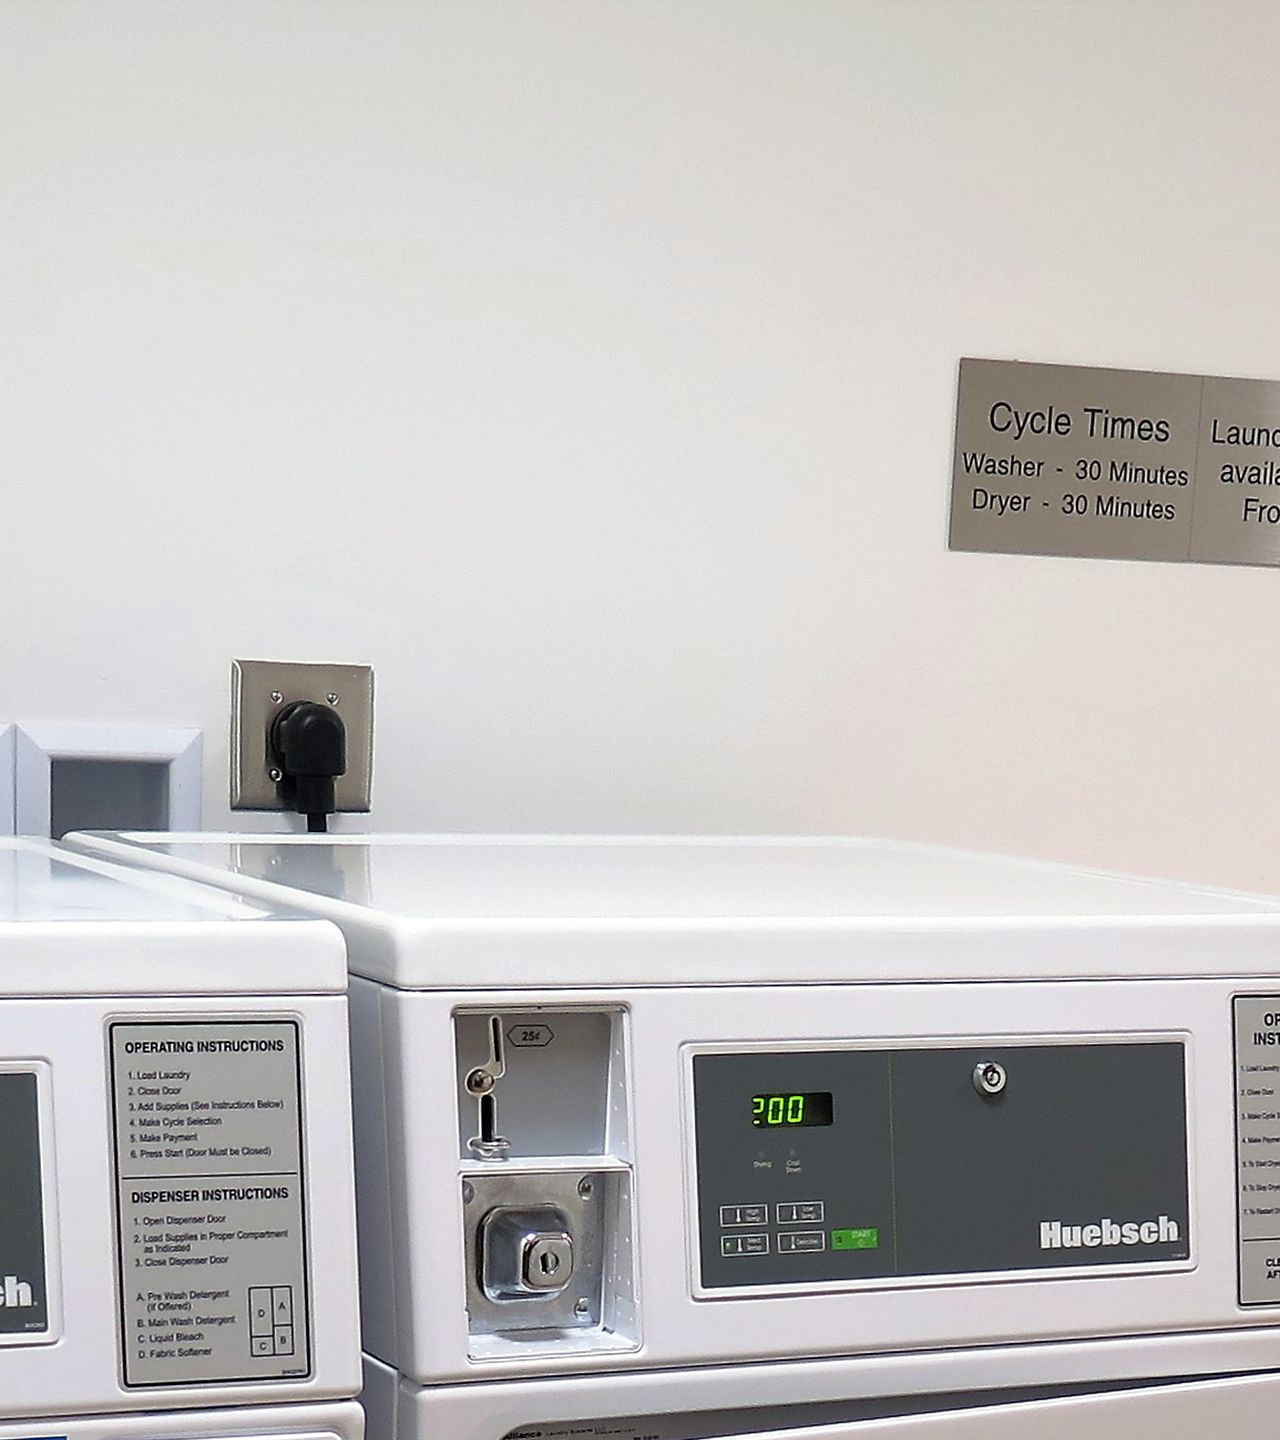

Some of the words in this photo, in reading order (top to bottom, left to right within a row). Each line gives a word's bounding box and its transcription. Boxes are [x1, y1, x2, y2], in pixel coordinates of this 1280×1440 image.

[989, 402, 1071, 440] Cycle
[1084, 409, 1171, 442] Times
[963, 452, 1044, 478] Washer
[1076, 460, 1102, 480] 30
[1108, 462, 1189, 486] Minutes
[972, 488, 1031, 515] Dryer
[1062, 494, 1088, 514] 30
[1095, 496, 1176, 520] Minutes
[125, 1042, 193, 1054] OPERATING
[197, 1040, 284, 1051] INSTRUCTIONS
[128, 1072, 135, 1080] 1.
[159, 1071, 190, 1081] Laundry
[138, 1087, 160, 1095] Close
[138, 1102, 154, 1111] Add
[156, 1102, 189, 1112] Supplies
[191, 1102, 209, 1111] (See
[212, 1101, 255, 1109] Instructions
[257, 1100, 283, 1109] Below)
[752, 1096, 803, 1124] 200
[139, 1118, 160, 1126] Make
[163, 1118, 184, 1127] Cycle
[187, 1117, 222, 1125] Selection
[140, 1134, 160, 1142] Make
[163, 1133, 197, 1143] Payment
[186, 1149, 206, 1157] (Door
[242, 1147, 271, 1156] Closed)
[132, 1191, 199, 1203] DISPENSER
[203, 1188, 288, 1201] INSTRUCTIONS
[134, 1217, 140, 1225] 1.
[143, 1217, 164, 1226] Open
[167, 1216, 205, 1225] Dispenser
[208, 1215, 226, 1223] Door
[143, 1235, 163, 1243] Load
[165, 1234, 198, 1243] Supplies
[200, 1233, 207, 1241] in
[210, 1232, 235, 1242] Proper
[237, 1230, 288, 1241] Compartment
[1041, 1216, 1179, 1248] Huebsch
[156, 1244, 190, 1253] Indicated
[145, 1258, 166, 1266] Close
[169, 1257, 207, 1267] Dispenser
[210, 1256, 229, 1264] Door
[137, 1293, 145, 1301] A.
[190, 1290, 229, 1300] Detergent
[158, 1302, 191, 1311] Offered)
[149, 1319, 168, 1327] Main
[171, 1318, 193, 1326] Wash
[196, 1316, 235, 1326] Detergent
[138, 1335, 146, 1343] C.
[149, 1334, 174, 1343] Liquid
[176, 1333, 203, 1341] Bleach
[280, 1336, 286, 1344] B
[259, 1342, 266, 1350] C
[151, 1349, 175, 1358] Fabric
[178, 1348, 211, 1356] Softener
[503, 1431, 541, 1440] Alliance
